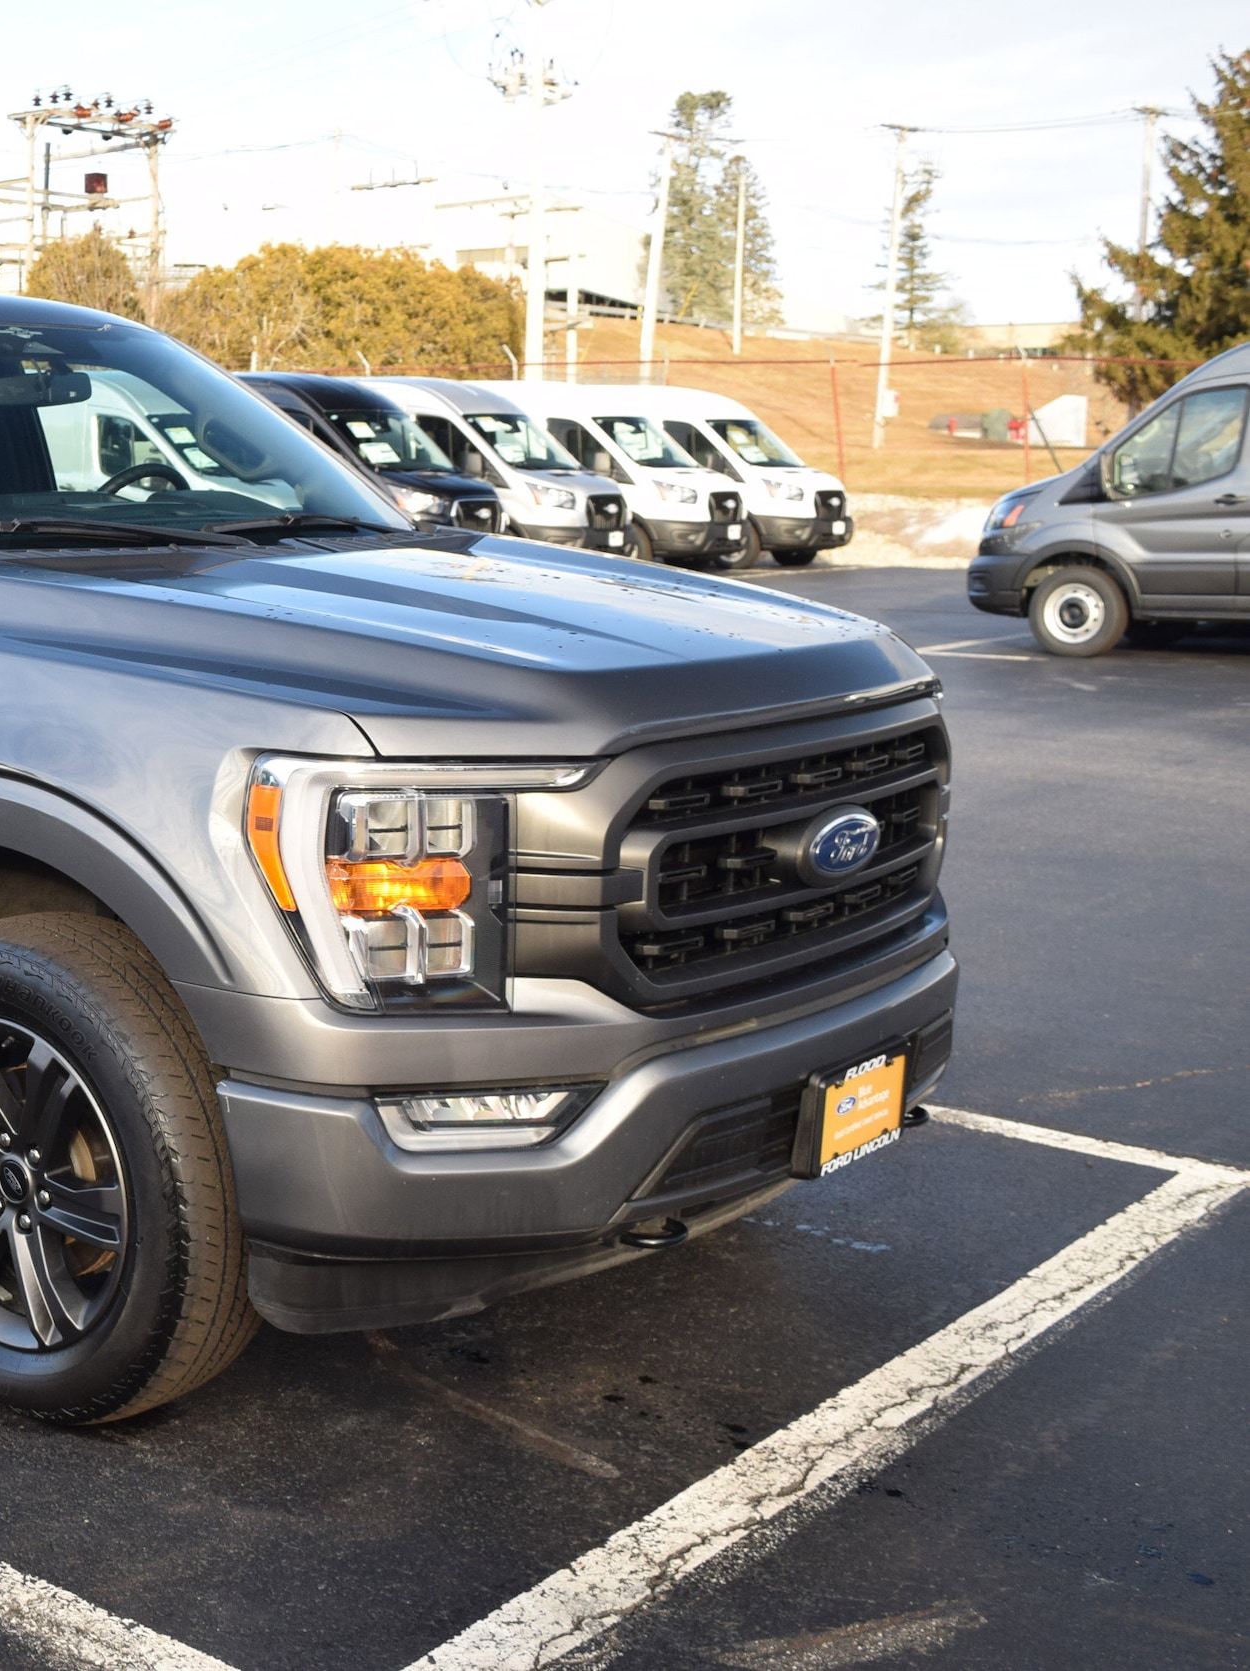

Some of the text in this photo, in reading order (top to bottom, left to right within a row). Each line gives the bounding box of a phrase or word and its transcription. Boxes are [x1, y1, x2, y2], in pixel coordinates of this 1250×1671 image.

[830, 824, 874, 864] Ford
[844, 1054, 887, 1082] FLOOD
[820, 1128, 902, 1177] FORD LINCOLN
